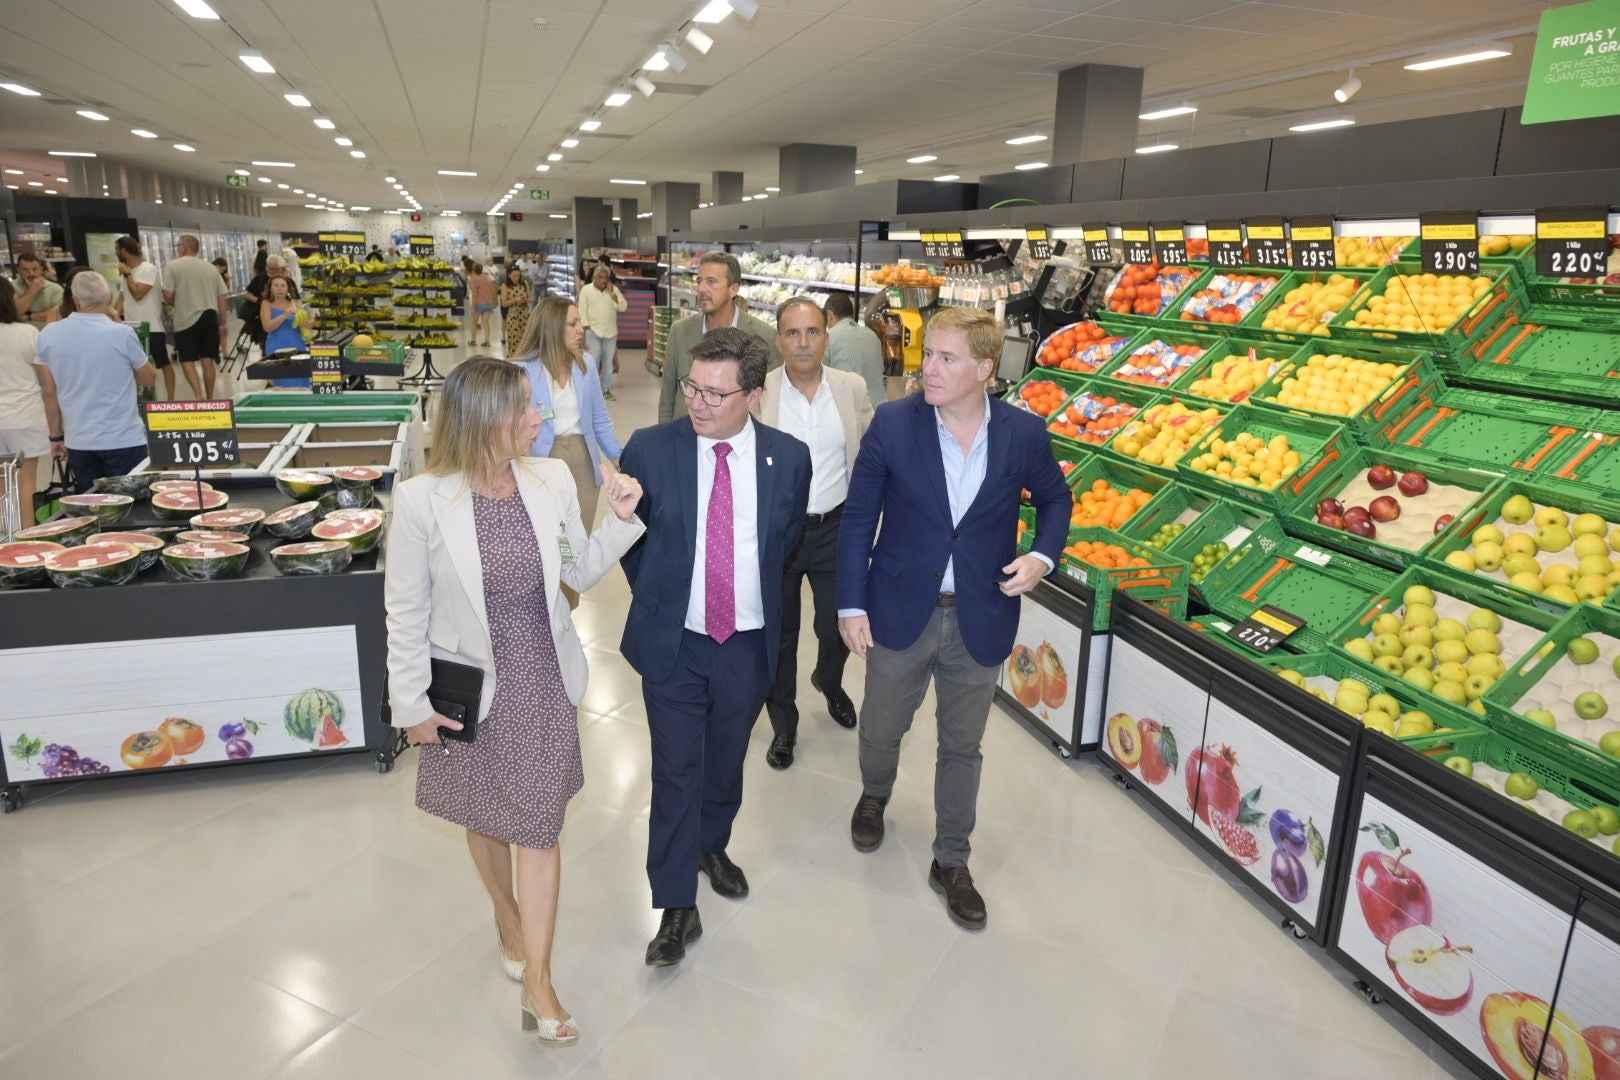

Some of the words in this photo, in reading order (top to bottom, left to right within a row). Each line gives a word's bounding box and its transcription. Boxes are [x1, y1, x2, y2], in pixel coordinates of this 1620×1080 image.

[1552, 30, 1603, 49] FRUTAS
[1607, 27, 1617, 39] Y
[1584, 44, 1595, 56] A
[151, 403, 182, 411] BAJADA
[197, 402, 226, 410] PRECIO
